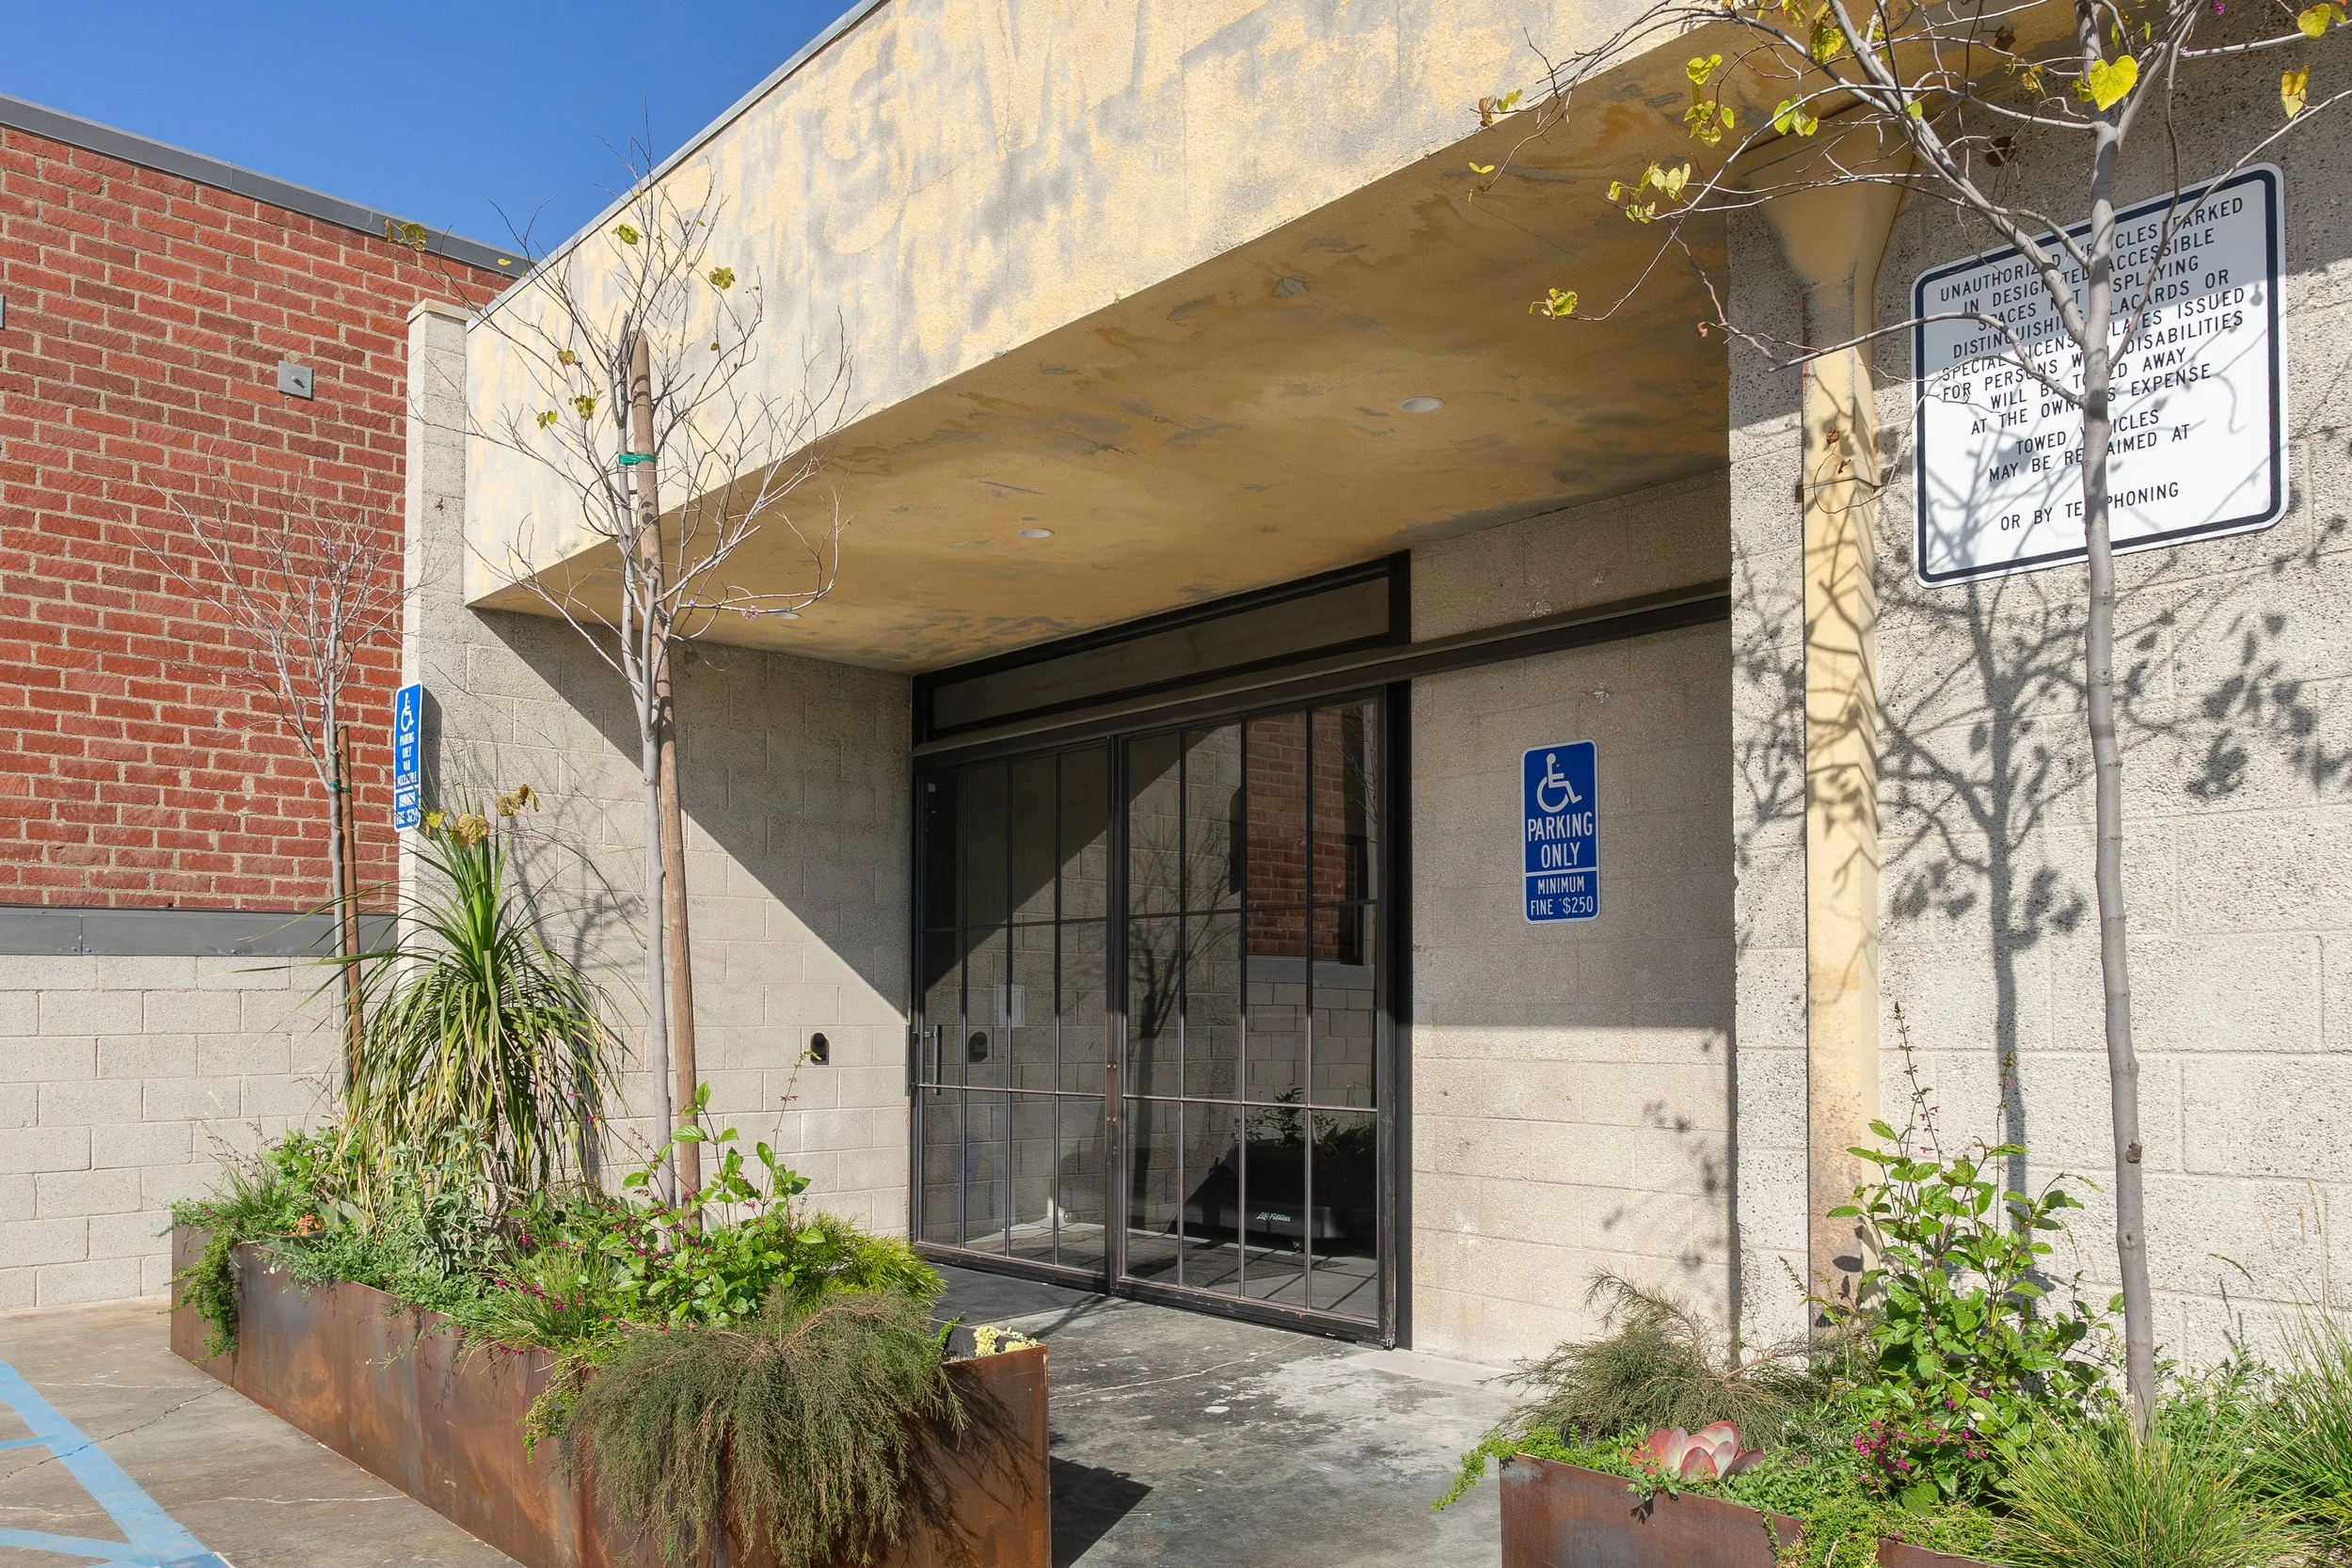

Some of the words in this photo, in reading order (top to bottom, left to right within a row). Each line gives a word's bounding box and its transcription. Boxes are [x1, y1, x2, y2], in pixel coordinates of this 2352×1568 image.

[1941, 253, 2060, 302] UNAUTHORID
[1964, 297, 1979, 315] IN
[1993, 265, 2090, 308] DESIGNTED
[2051, 289, 2082, 311] NT
[2109, 255, 2200, 293] SPLYING
[2205, 269, 2230, 289] OR
[1942, 353, 2007, 382] SPECIAL
[2026, 335, 2077, 360] ICENS
[2107, 309, 2162, 337] LAES
[2178, 287, 2245, 319] ISSUED
[1943, 382, 1971, 402] FOR
[2125, 310, 2243, 355] DISABILITIES
[1971, 418, 1987, 436] AT
[1999, 408, 2028, 428] THE
[2131, 363, 2211, 396] EXPENSE
[1991, 388, 2027, 410] WILL
[2142, 347, 2186, 372] AWAY
[1989, 462, 2019, 483] MAY
[2032, 455, 2051, 472] BE
[2064, 432, 2157, 467] REAIMED
[2171, 423, 2190, 443] AT
[2016, 431, 2067, 454] TOWED
[2001, 514, 2021, 531] OR
[2034, 507, 2053, 525] BY
[2065, 482, 2179, 518] TEPHONING
[1527, 811, 1593, 842] PARKING
[1540, 842, 1581, 868] ONLY
[1530, 899, 1554, 916] FINE
[1562, 895, 1594, 915] $250
[1537, 876, 1585, 895] MINIMUM
